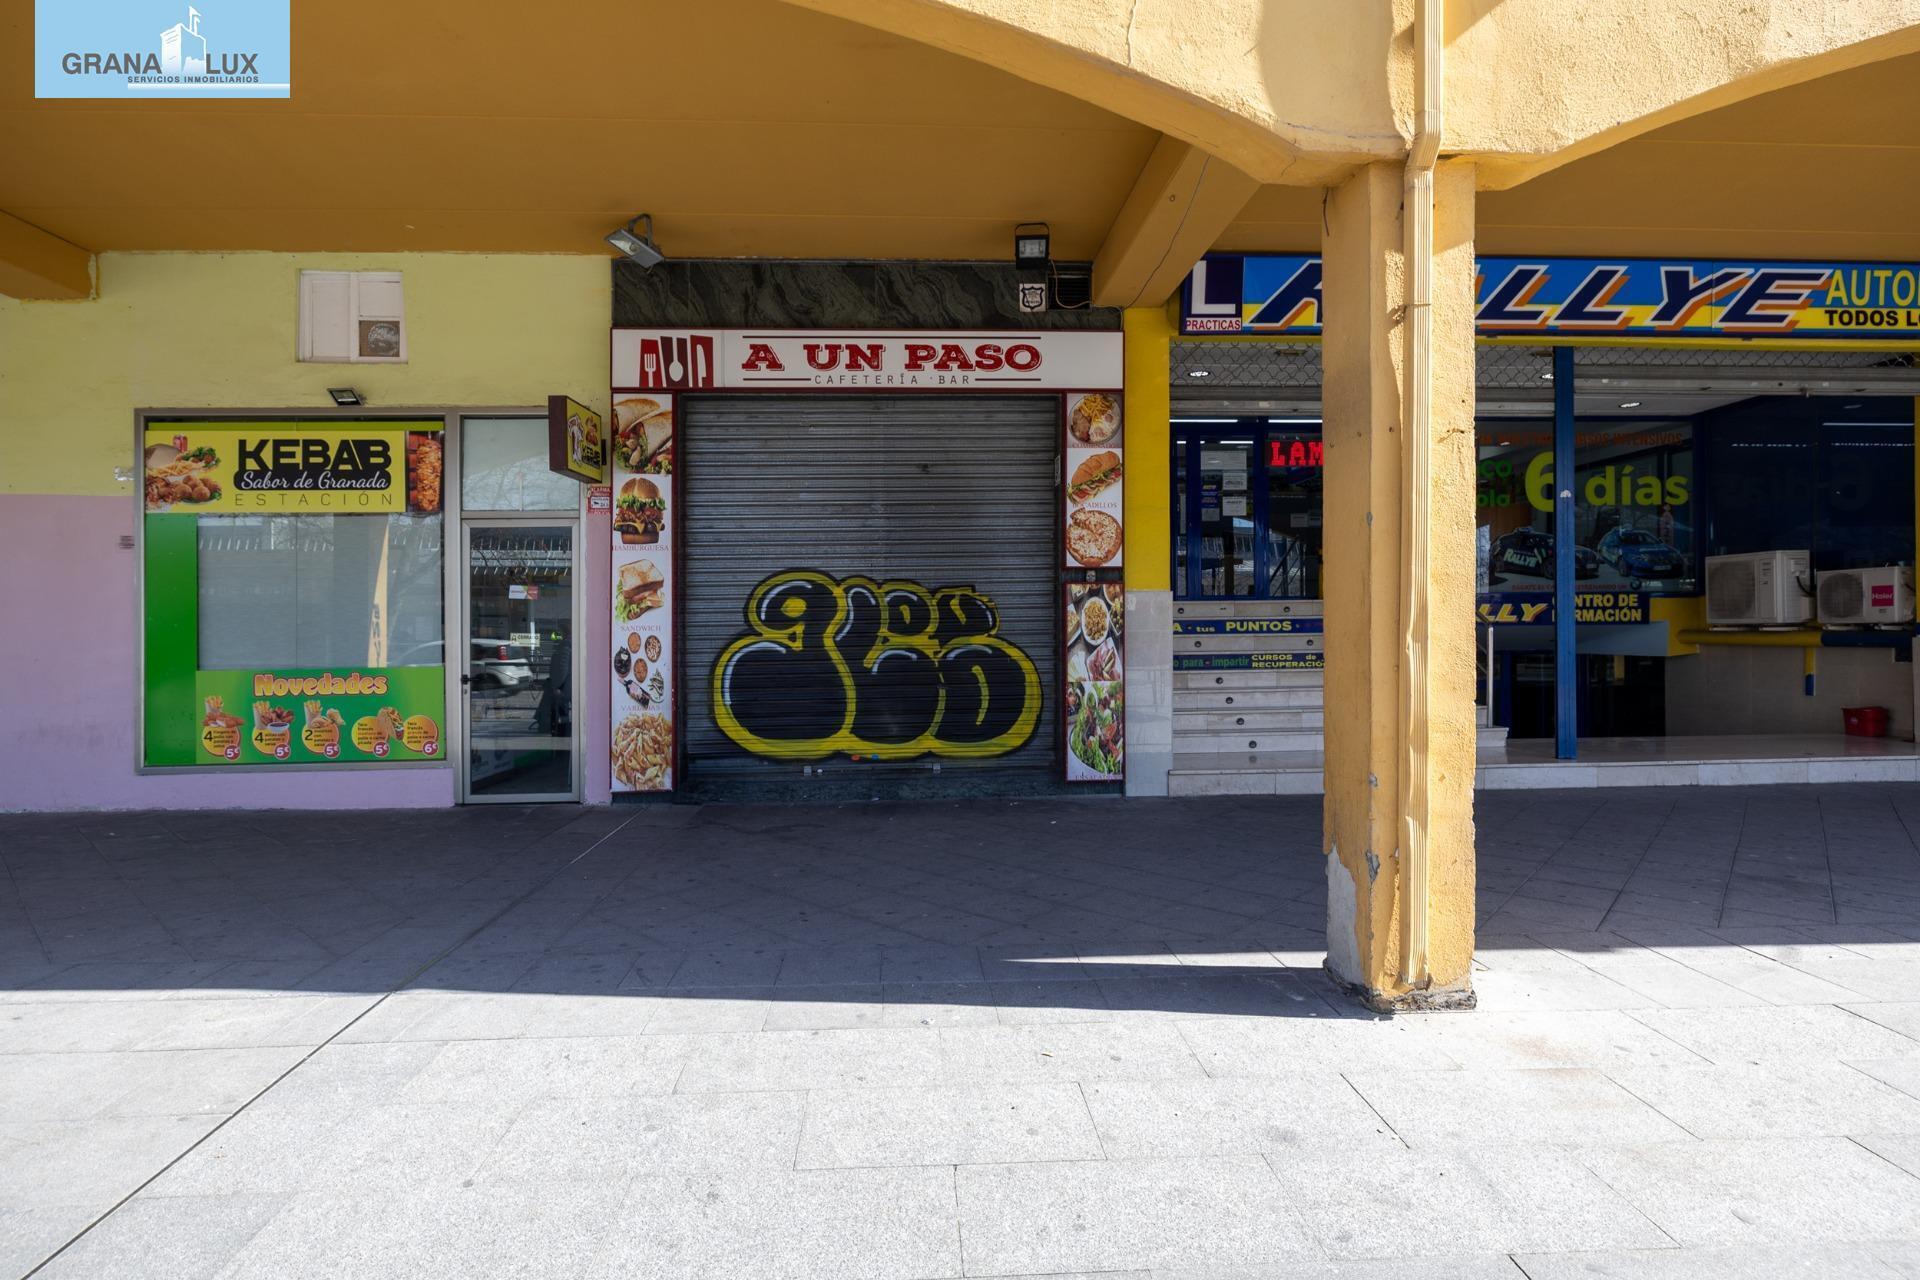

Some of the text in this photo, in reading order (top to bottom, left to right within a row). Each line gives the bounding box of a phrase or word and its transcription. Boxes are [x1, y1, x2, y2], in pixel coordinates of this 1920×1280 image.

[1825, 268, 1920, 307] AUTO
[1186, 318, 1241, 331] PRACTICAS
[1824, 309, 1920, 327] TODOS L
[741, 343, 1043, 372] A UN PASO
[814, 372, 971, 385] CAFETERÍA BAR
[237, 438, 392, 471] KEBAB
[240, 470, 389, 490] Sabor de Granada
[1584, 464, 1689, 506] días
[234, 490, 392, 506] ESTACIÓN
[1552, 594, 1638, 606] NTRO DE
[1476, 603, 1548, 623] LLY
[1552, 606, 1641, 622] RMACIÓN
[1196, 625, 1215, 633] tus
[1226, 621, 1292, 632] PUNTOS
[252, 672, 388, 697] Novedades
[204, 730, 213, 742] 4
[254, 731, 264, 743] 4
[304, 729, 313, 741] 2
